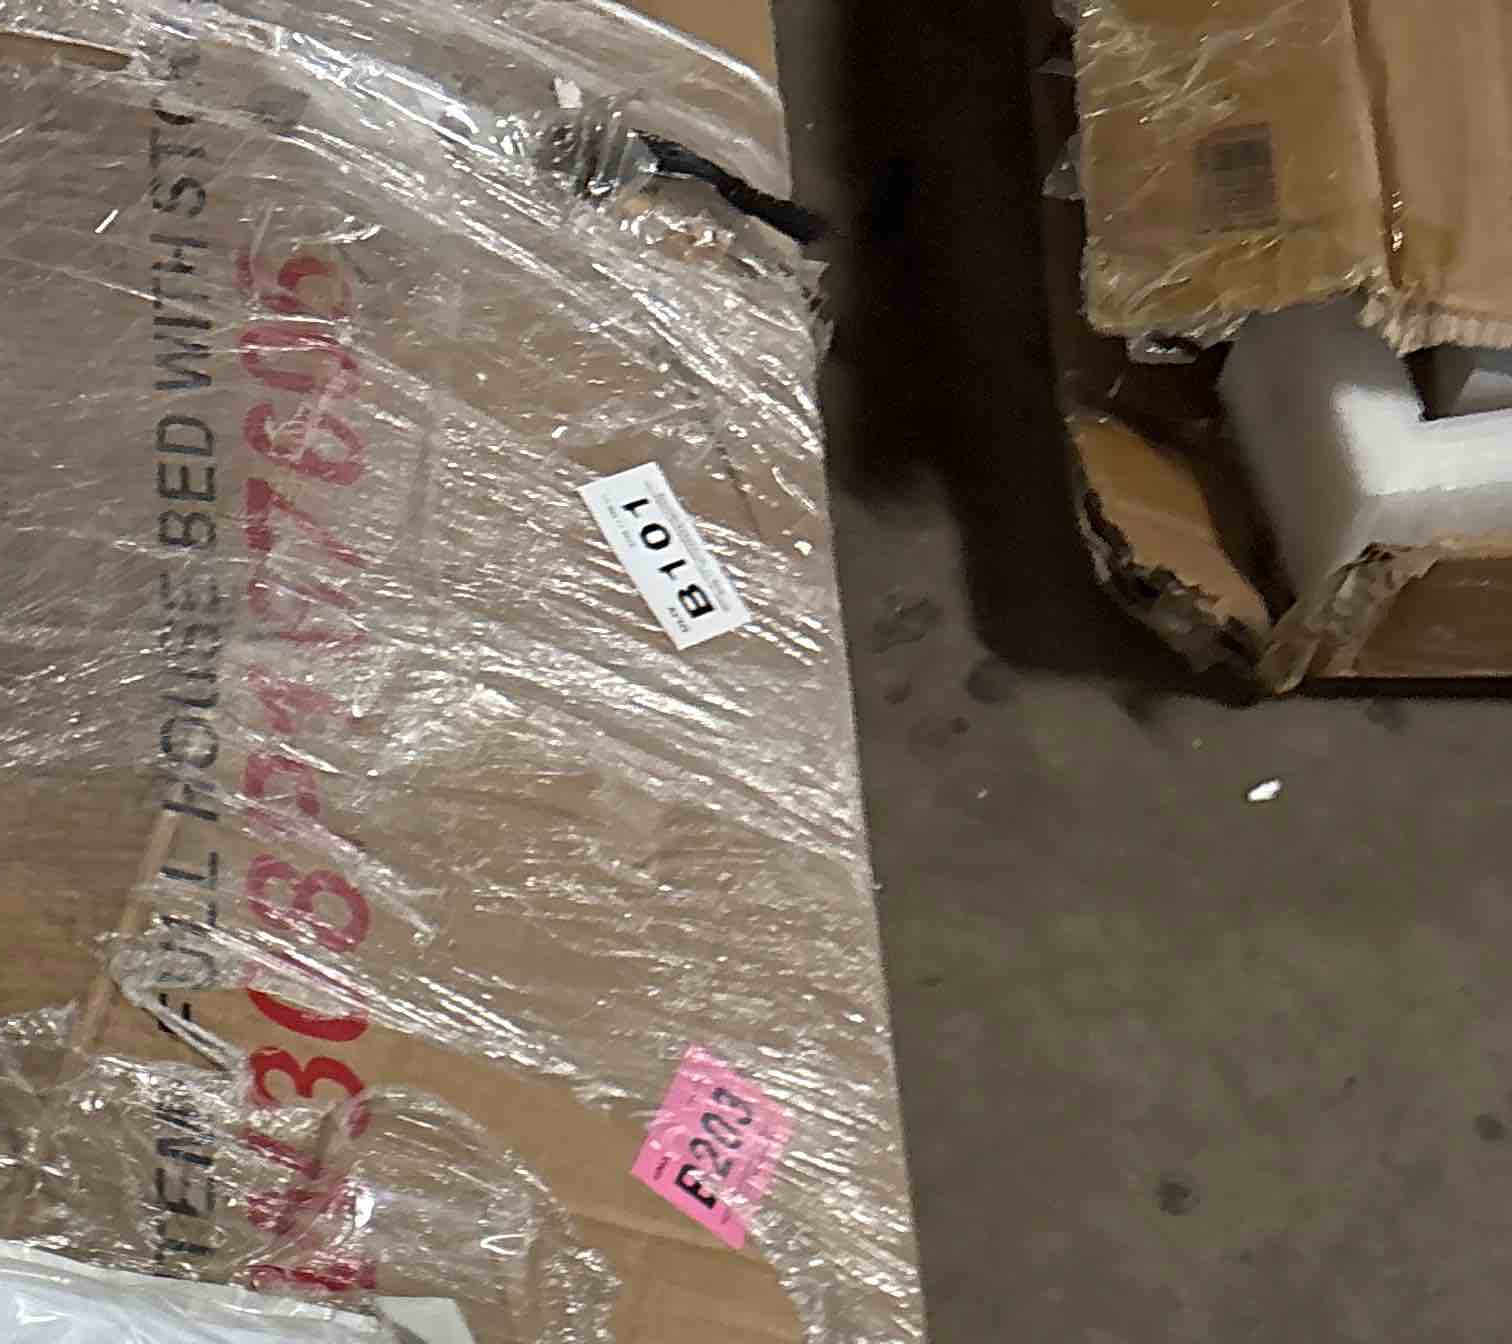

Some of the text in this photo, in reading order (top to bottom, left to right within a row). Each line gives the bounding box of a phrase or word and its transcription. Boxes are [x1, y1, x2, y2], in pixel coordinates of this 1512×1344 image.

[150, 232, 213, 392] WITH
[155, 412, 216, 549] BED
[621, 496, 714, 620] B101
